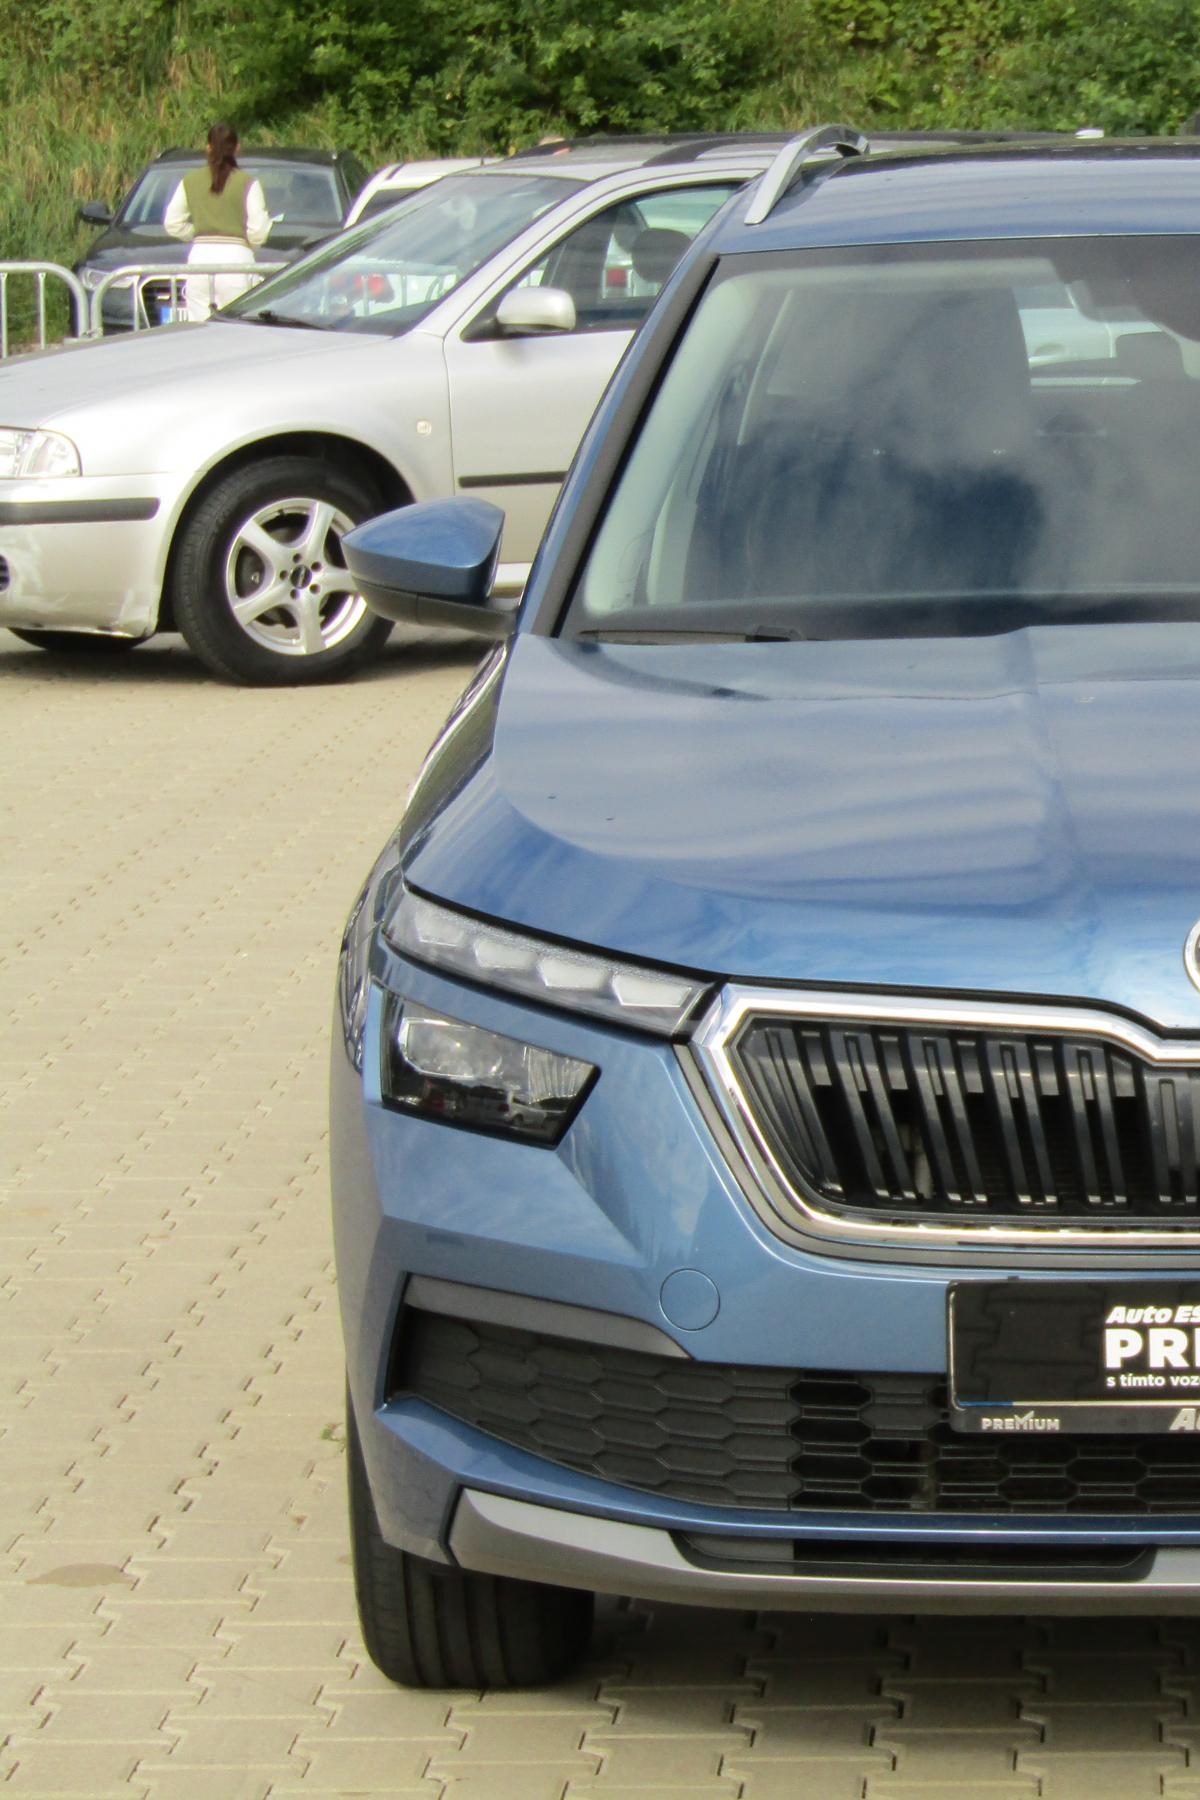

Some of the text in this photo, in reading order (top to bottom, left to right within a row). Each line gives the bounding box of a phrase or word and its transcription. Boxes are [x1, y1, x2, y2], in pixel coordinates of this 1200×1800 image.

[1105, 1305, 1173, 1324] Auto
[1106, 1376, 1116, 1387] s
[981, 1410, 1060, 1430] PREMIUM
